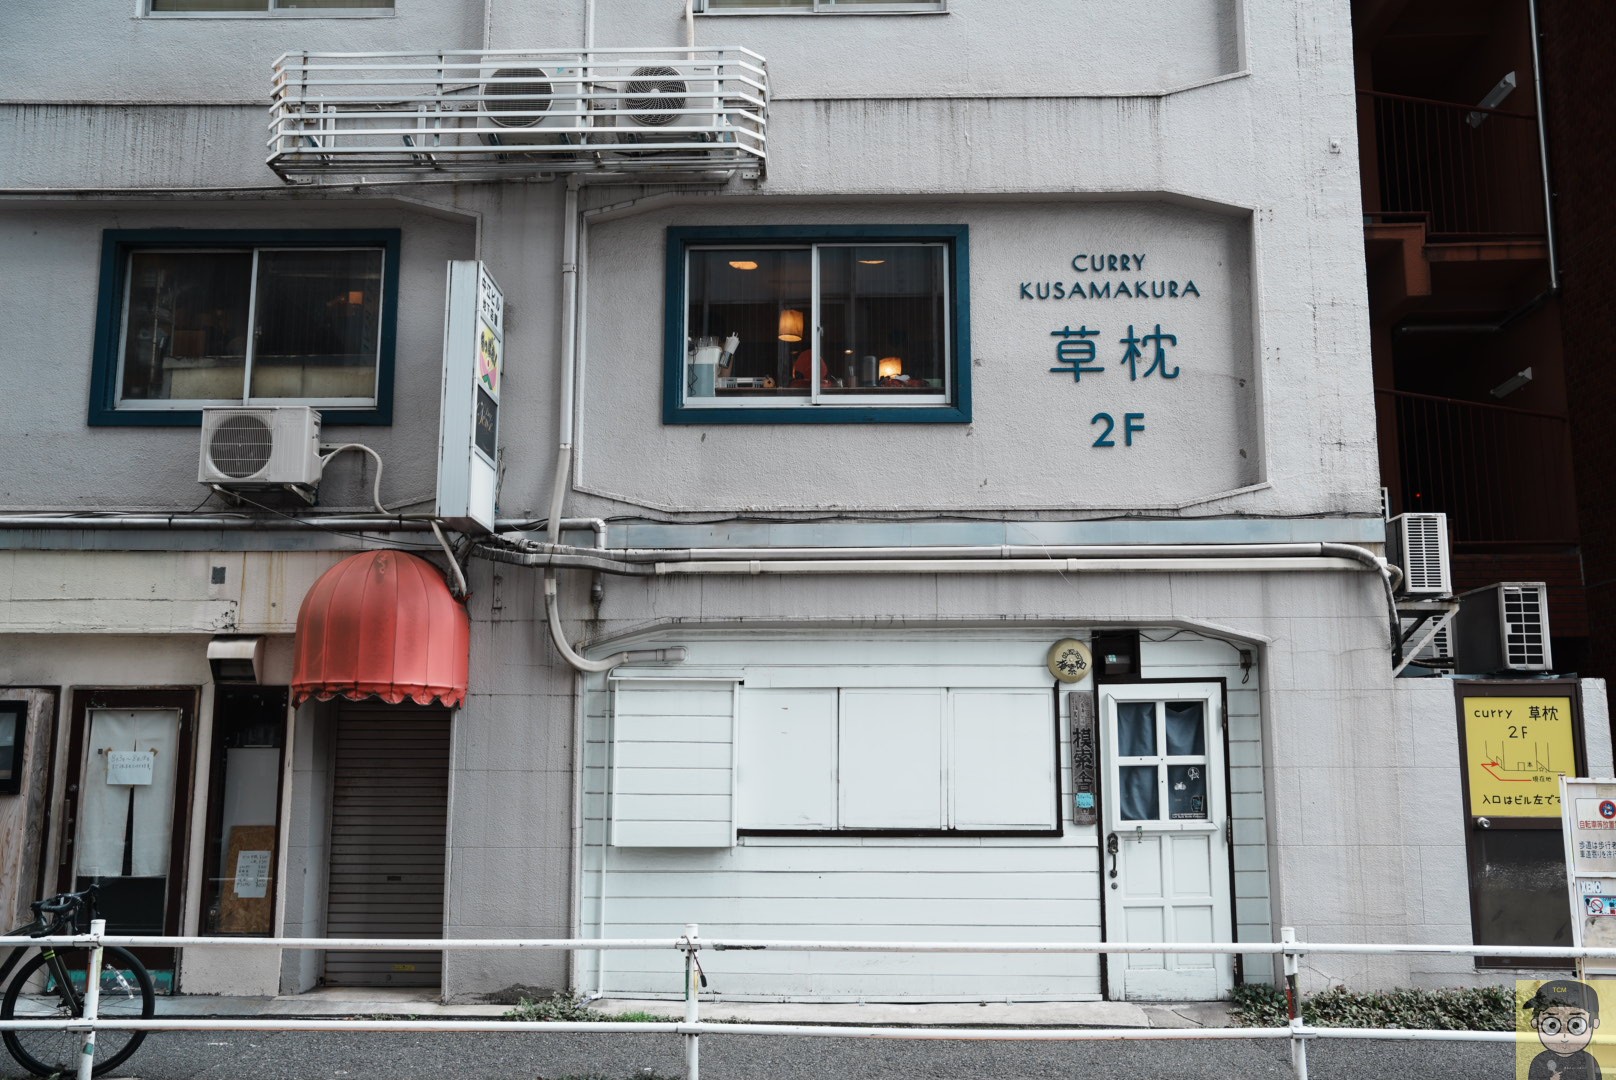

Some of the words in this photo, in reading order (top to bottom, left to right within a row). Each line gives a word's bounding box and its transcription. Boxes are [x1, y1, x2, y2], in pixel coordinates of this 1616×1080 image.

[1072, 253, 1146, 272] CURRY
[1020, 279, 1200, 300] KUSAMAKURA
[1050, 324, 1180, 382] 草枕
[1091, 412, 1145, 447] 2F
[1474, 709, 1512, 719] curry
[1528, 705, 1559, 721] 草枕
[1508, 725, 1528, 739] 2F
[1580, 820, 1616, 829] 自転車等放置
